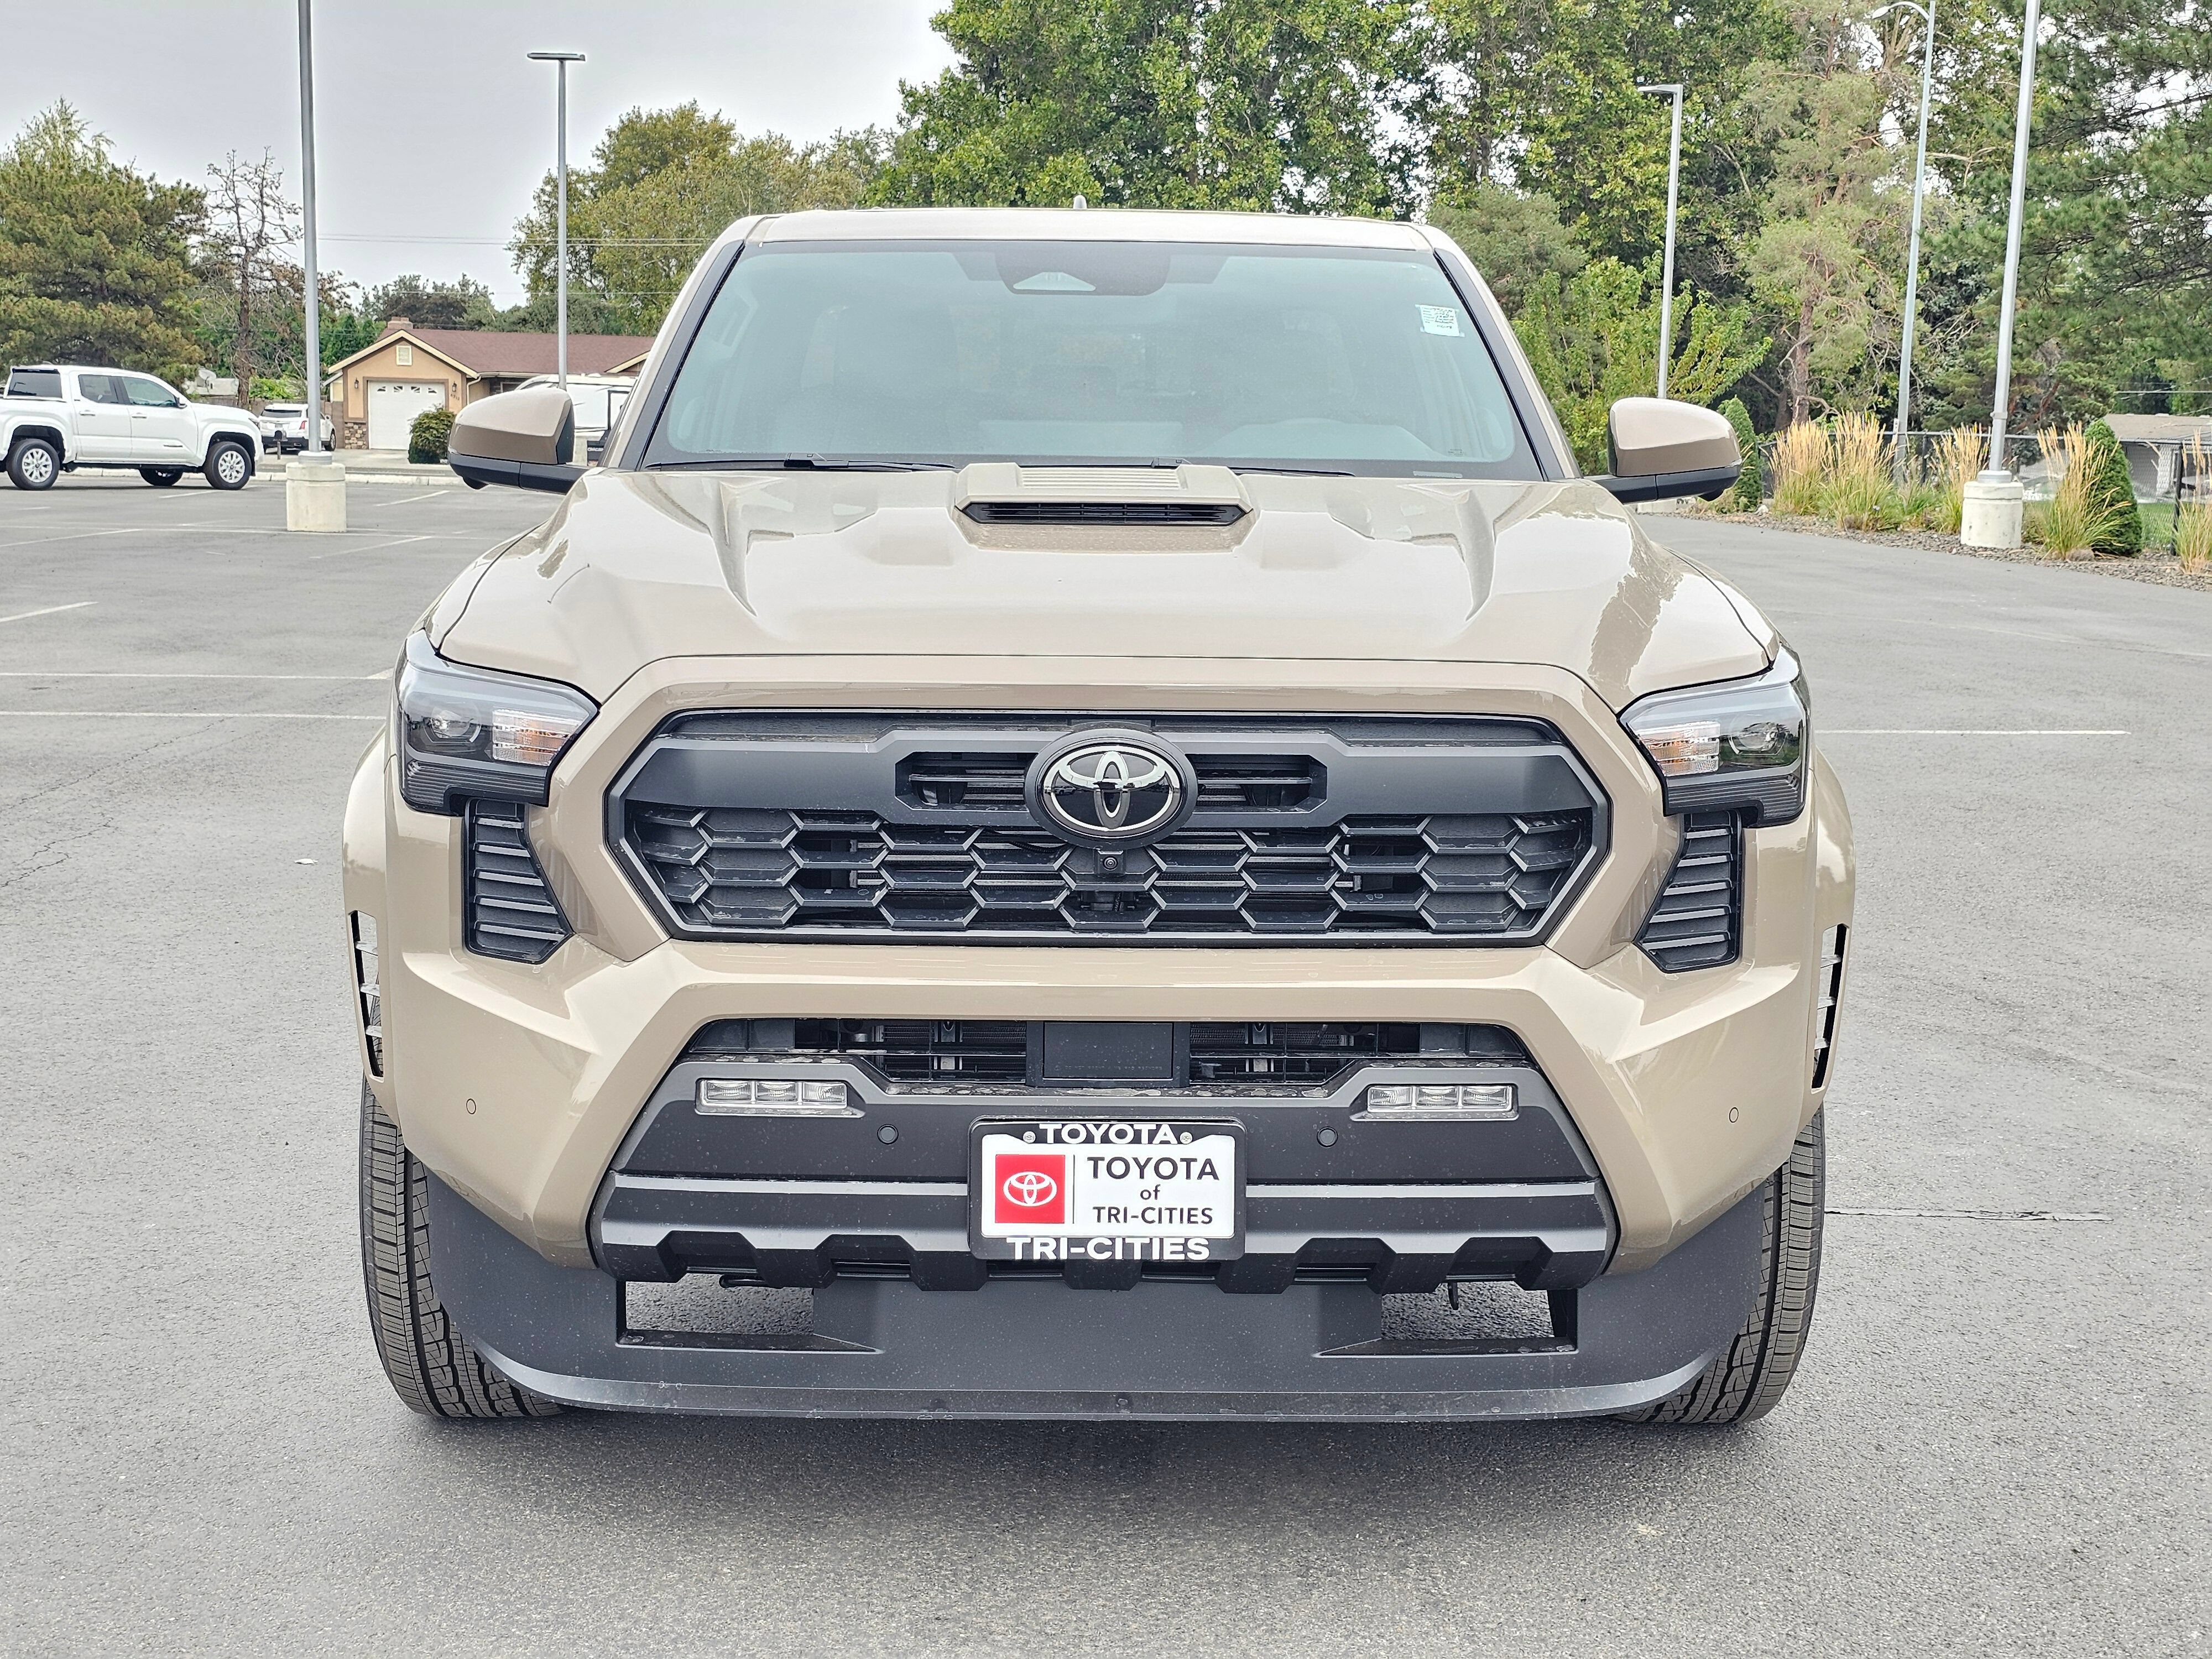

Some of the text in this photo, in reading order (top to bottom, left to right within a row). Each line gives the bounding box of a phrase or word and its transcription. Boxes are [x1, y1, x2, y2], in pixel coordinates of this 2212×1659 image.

[1039, 1123, 1178, 1144] TOYOTA
[1087, 1156, 1220, 1181] TOYOTA
[1140, 1184, 1161, 1201] of
[1092, 1206, 1213, 1224] TRI-CITIES
[1006, 1237, 1210, 1260] TRI-CITIES
